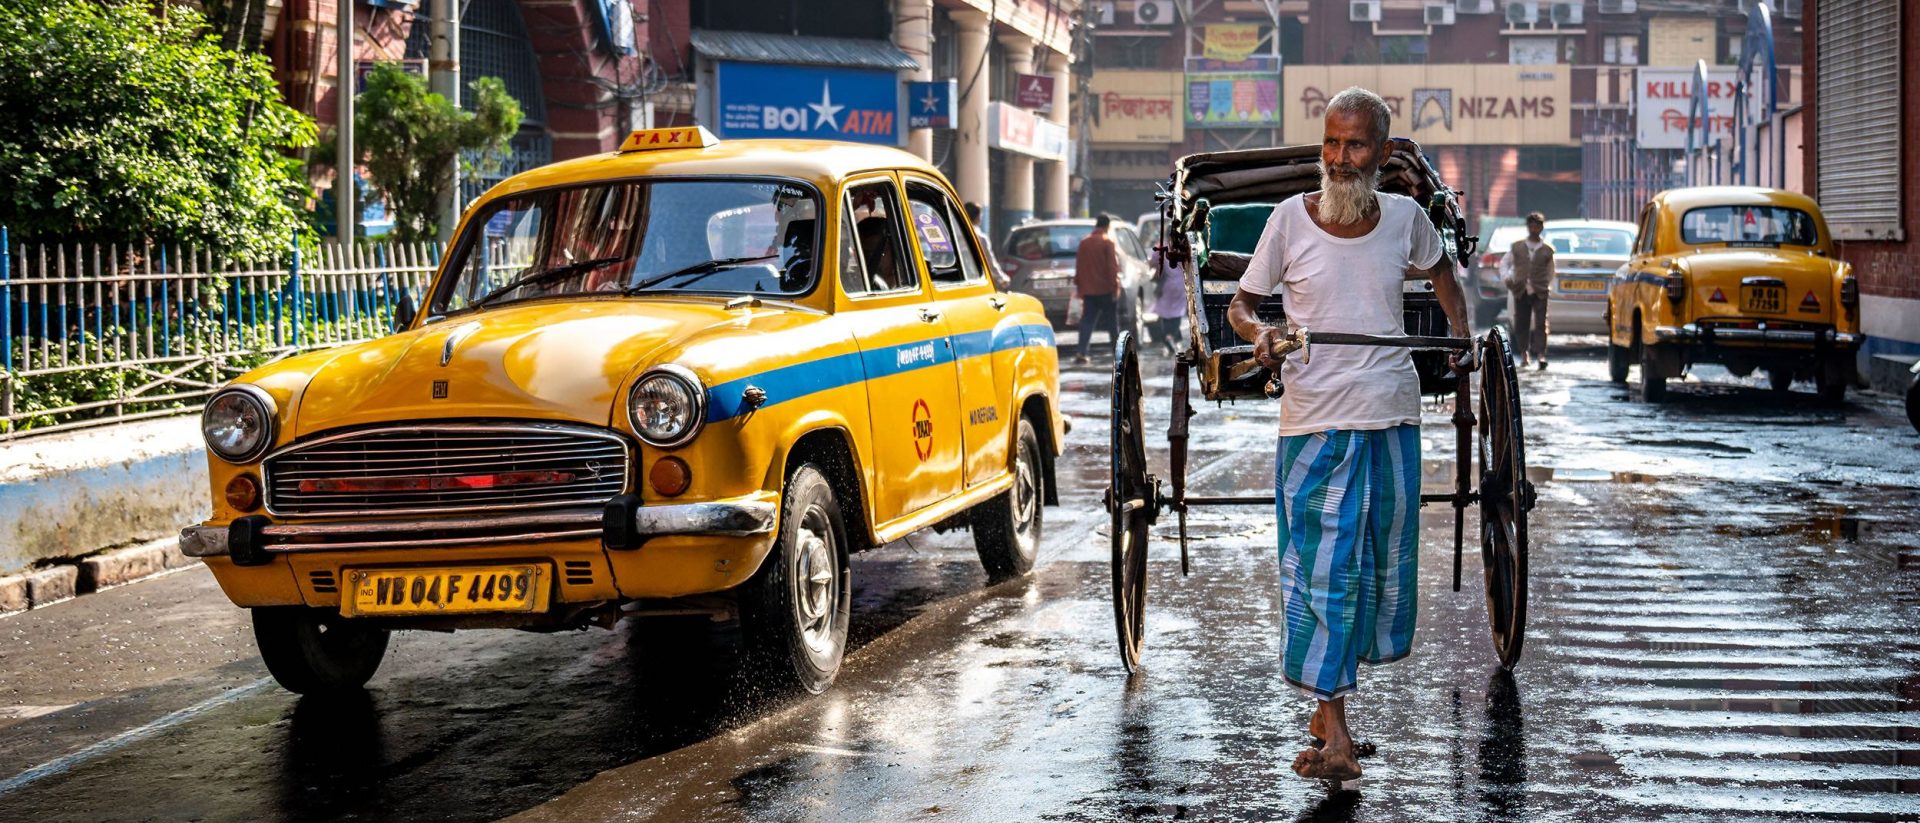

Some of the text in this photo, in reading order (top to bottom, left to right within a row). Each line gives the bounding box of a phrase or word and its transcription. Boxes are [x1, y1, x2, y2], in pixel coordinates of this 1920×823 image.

[1647, 82, 1722, 98] KILLR
[1459, 97, 1555, 118] NIZAMS
[764, 106, 893, 135] BOI ATM
[911, 116, 949, 127] BOI ATM
[633, 131, 693, 145] TAXI
[977, 406, 998, 423] REFUSAL
[360, 588, 374, 597] IND
[377, 574, 529, 605] WB 04 F 4499
